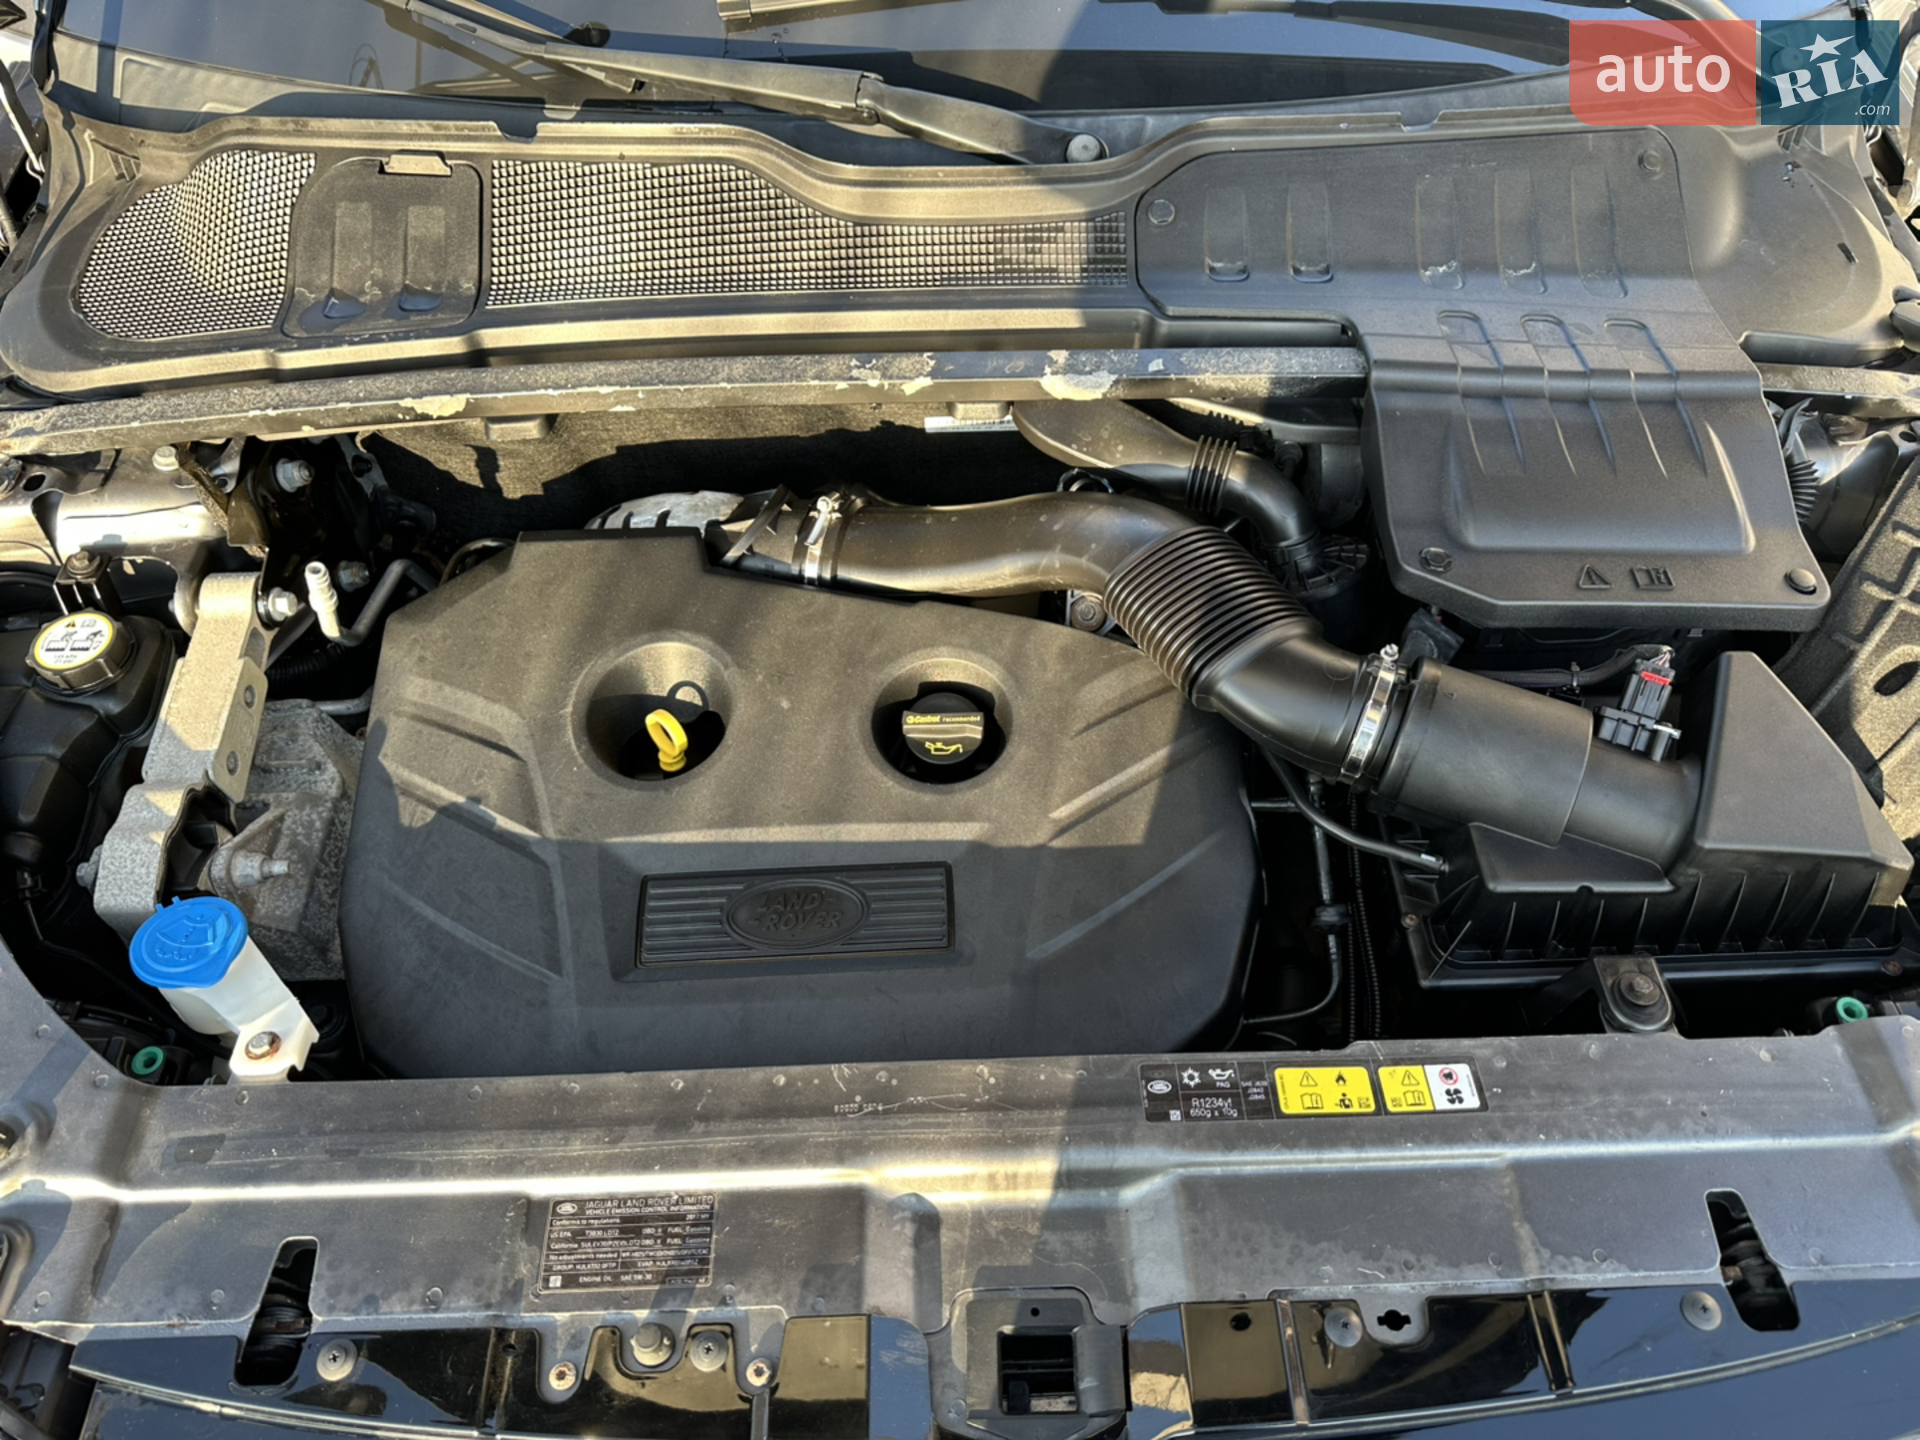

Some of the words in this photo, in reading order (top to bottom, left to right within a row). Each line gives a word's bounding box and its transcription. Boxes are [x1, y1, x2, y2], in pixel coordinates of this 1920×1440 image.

[915, 715, 940, 723] Castrol
[1191, 1097, 1233, 1109] R1234yf
[1190, 1108, 1211, 1118] 650g
[1222, 1107, 1238, 1117] 10g
[585, 1200, 619, 1209] JAGUAR
[620, 1198, 646, 1207] LAND
[647, 1197, 677, 1207] ROVER
[678, 1195, 714, 1205] LIMITED
[585, 1208, 611, 1216] VEHICLE
[611, 1206, 641, 1214] EMISSION
[669, 1204, 711, 1212] INFORMATION
